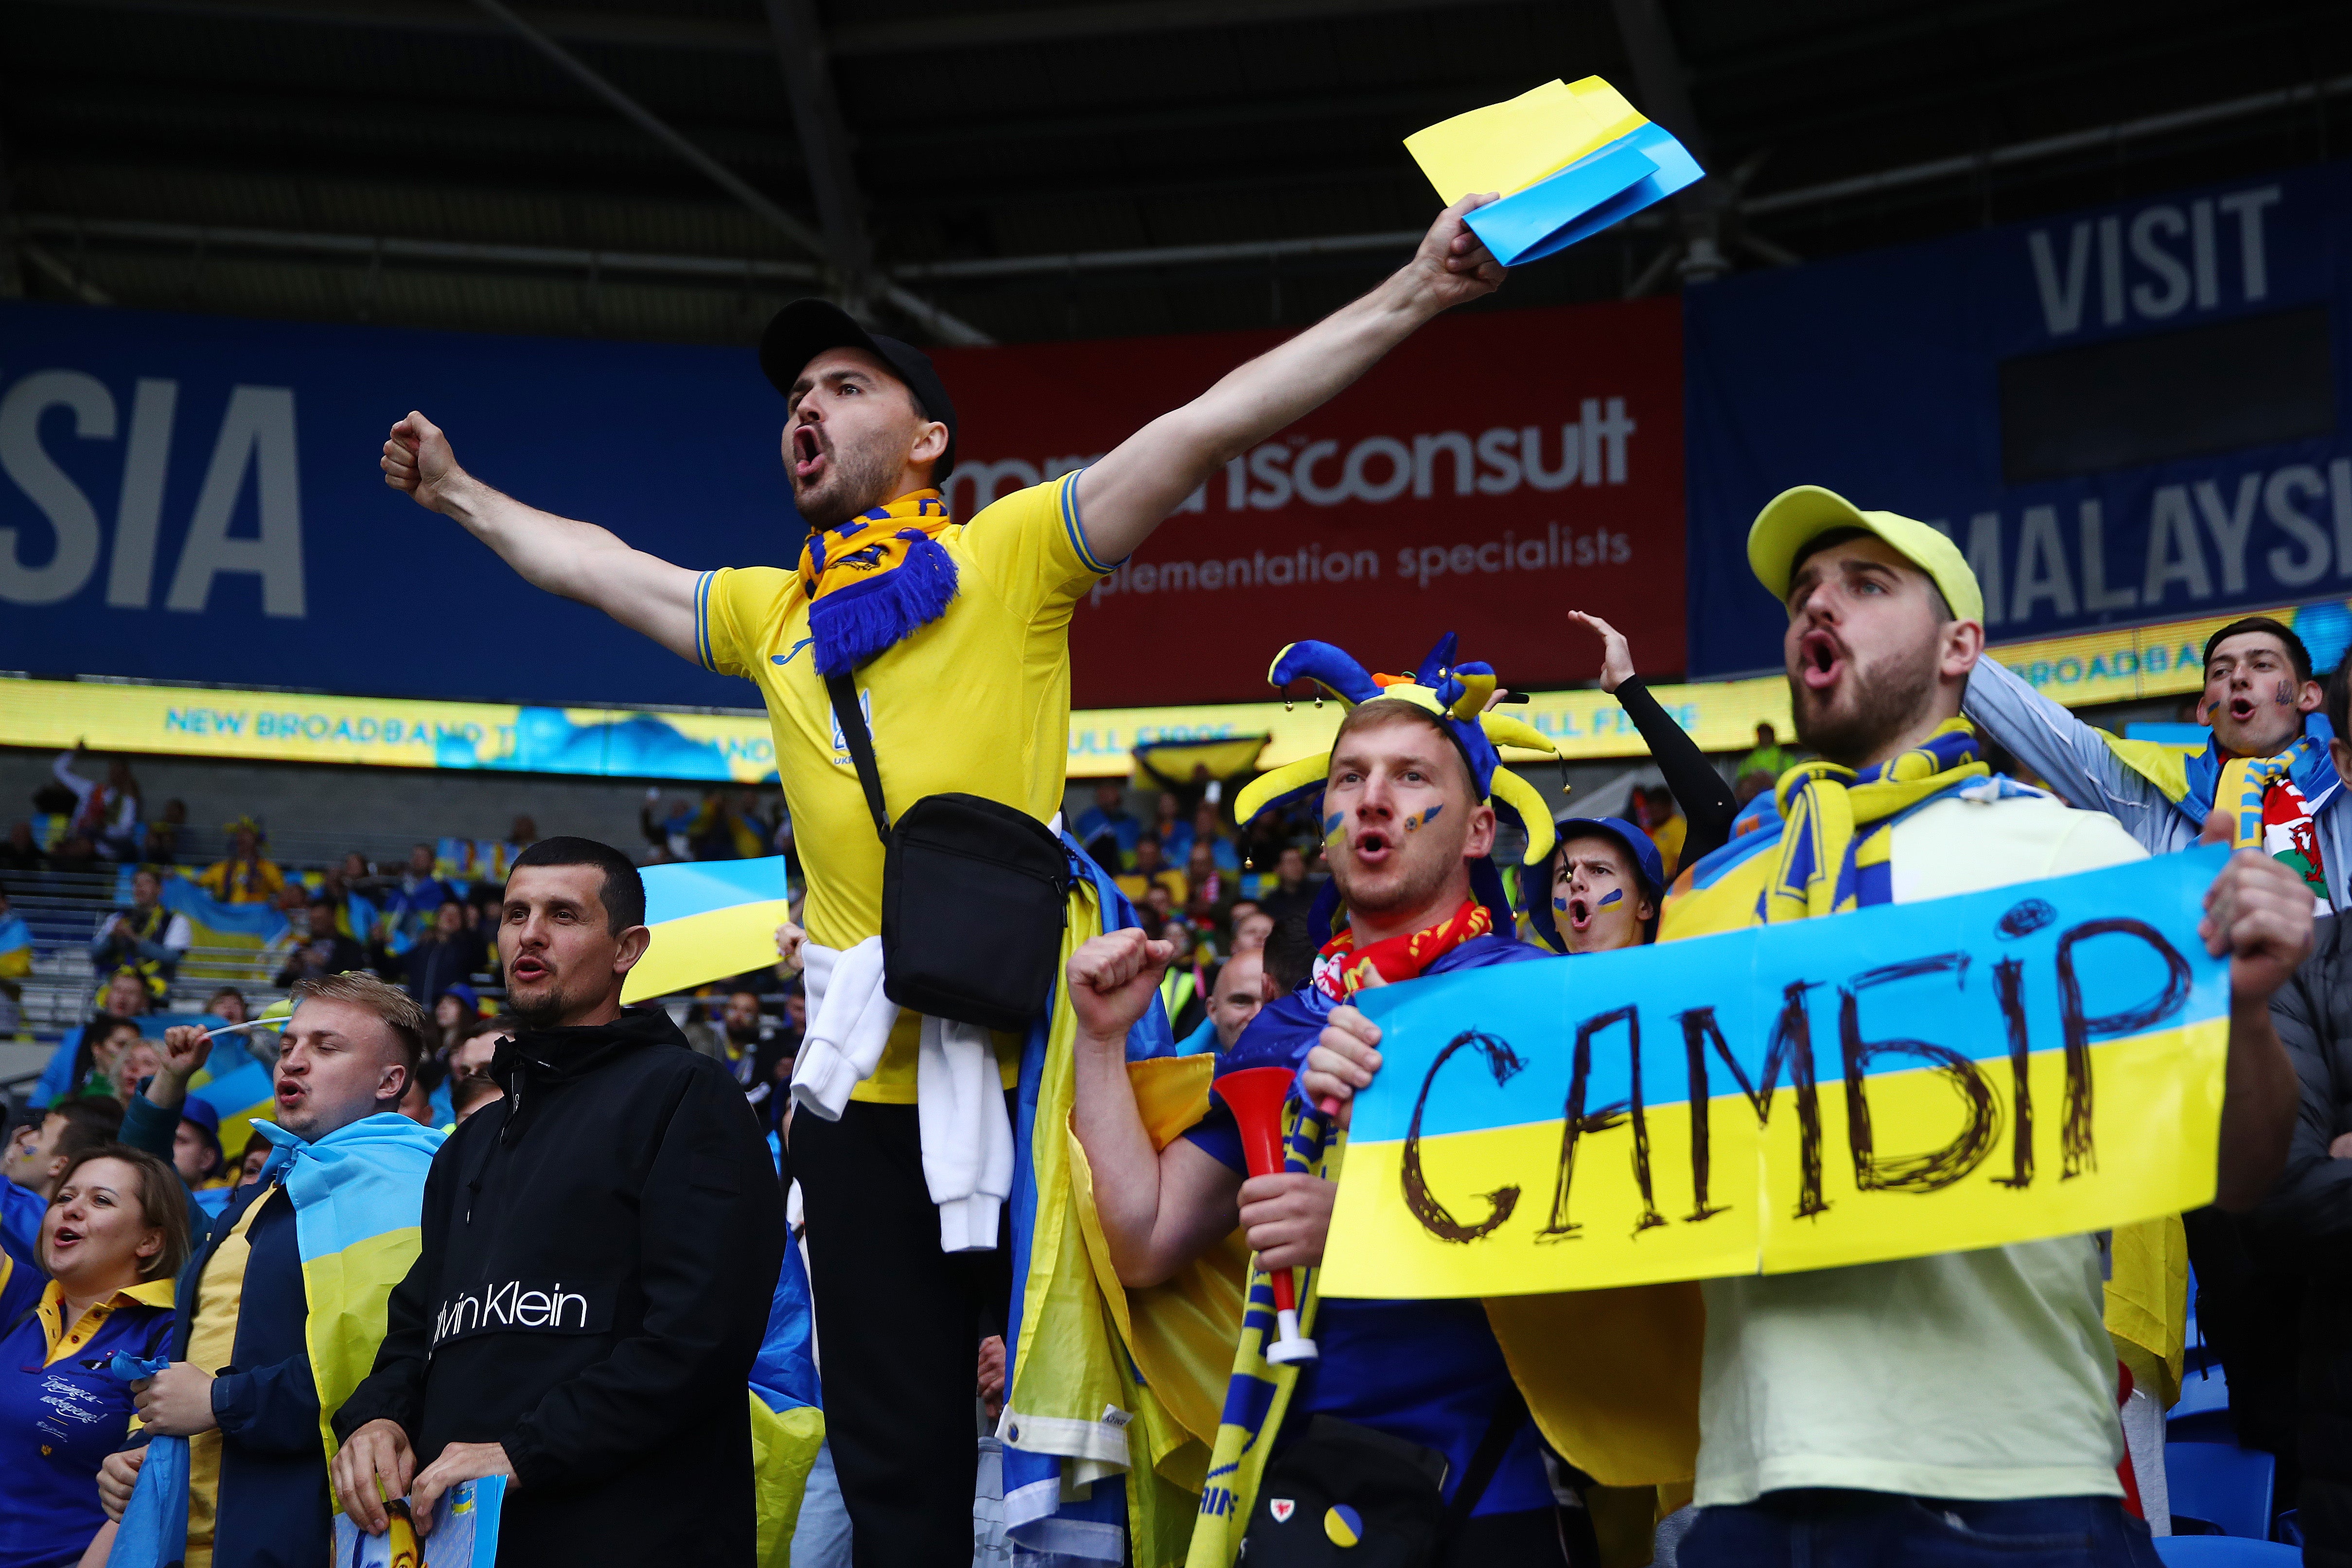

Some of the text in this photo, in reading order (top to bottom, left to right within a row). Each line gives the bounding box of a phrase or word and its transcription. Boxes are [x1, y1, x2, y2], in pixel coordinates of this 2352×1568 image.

[2027, 184, 2284, 338] VISIT
[0, 367, 307, 619] SIA
[1090, 524, 1631, 609] plementation specialists
[167, 708, 247, 736] NEW
[482, 1281, 587, 1328] Klein
